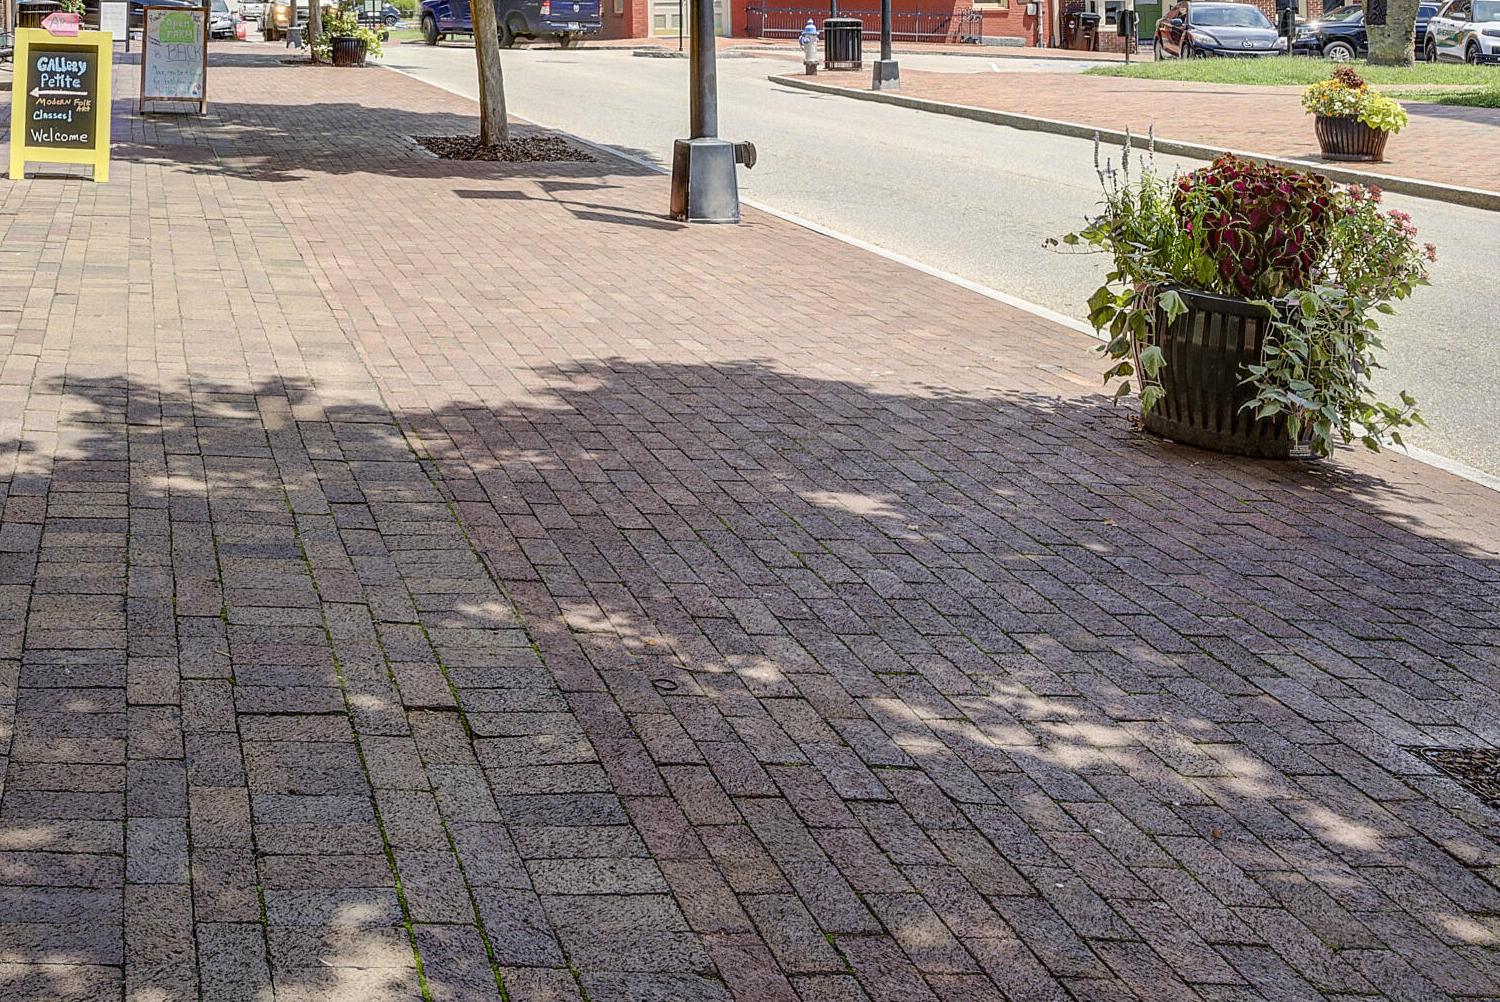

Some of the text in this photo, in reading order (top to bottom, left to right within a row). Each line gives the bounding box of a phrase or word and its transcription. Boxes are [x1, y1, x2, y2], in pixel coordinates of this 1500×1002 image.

[41, 73, 81, 88] Petite
[33, 109, 73, 122] Classes!
[30, 127, 88, 143] Welcome
